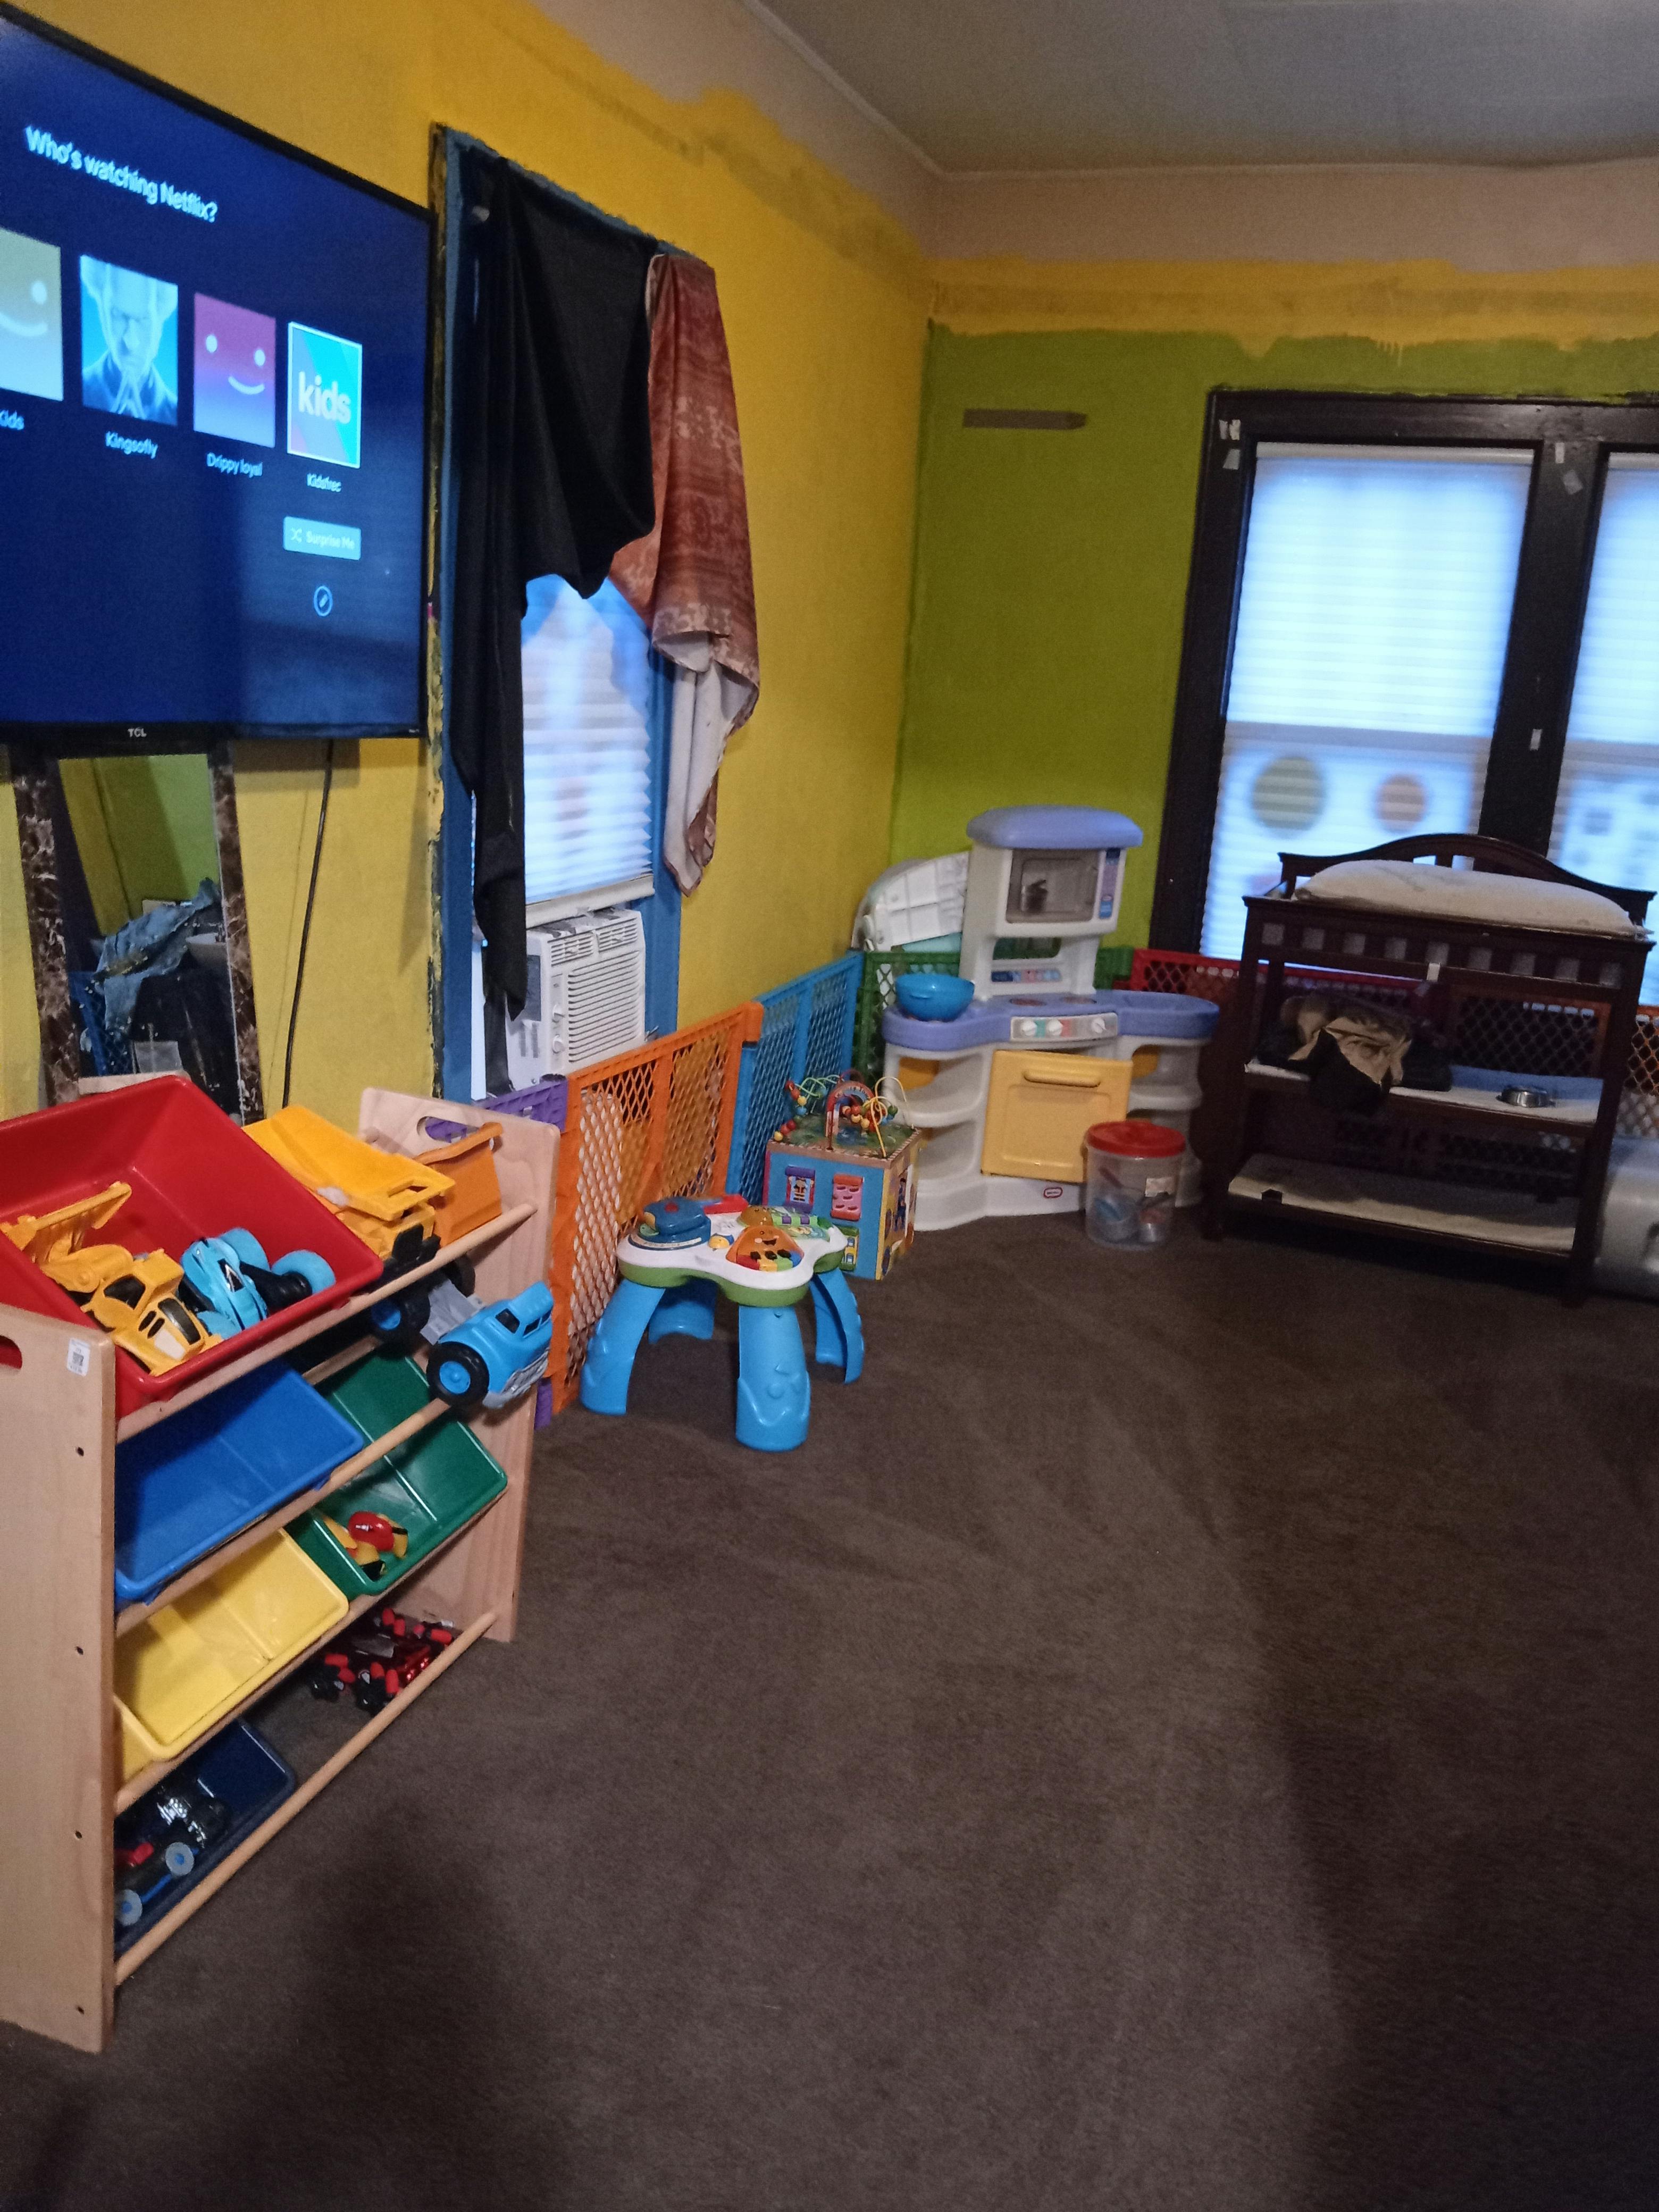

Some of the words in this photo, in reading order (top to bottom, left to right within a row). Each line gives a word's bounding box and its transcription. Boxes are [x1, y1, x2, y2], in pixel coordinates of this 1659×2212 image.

[25, 125, 82, 170] Who's
[84, 155, 158, 205] watching
[160, 181, 218, 223] Netflix?
[298, 371, 351, 424] kids
[128, 727, 147, 738] TCL
